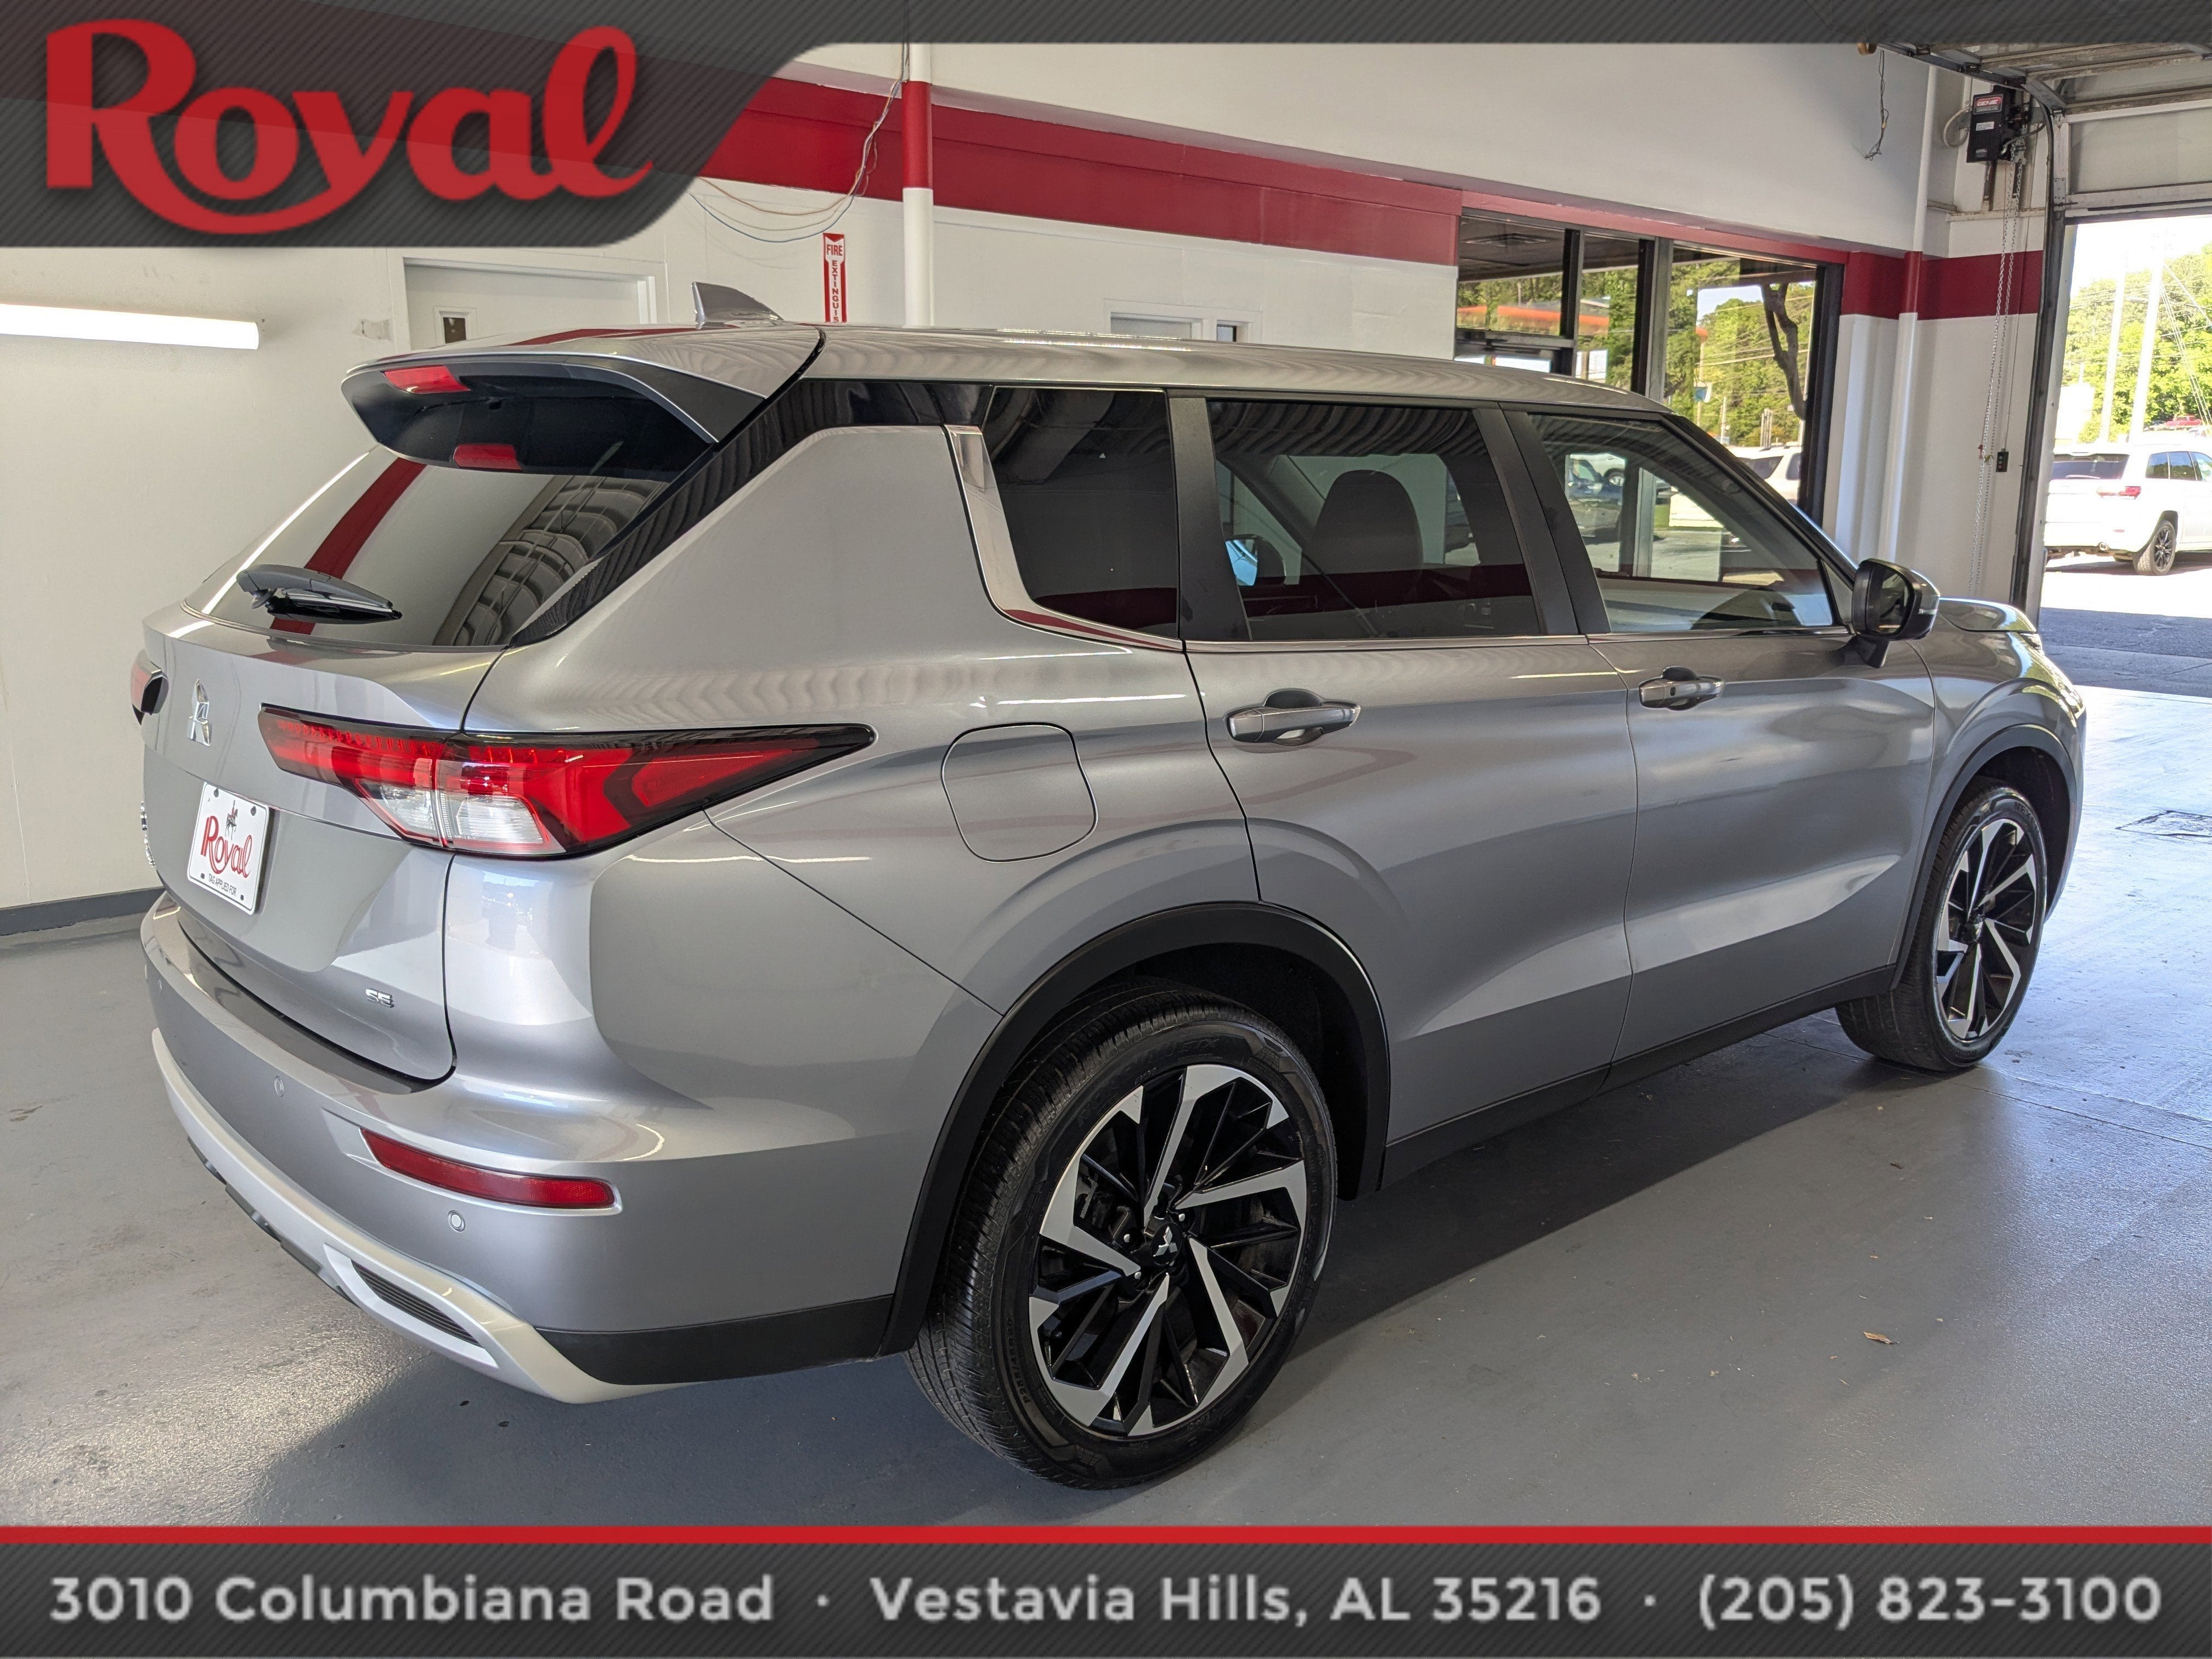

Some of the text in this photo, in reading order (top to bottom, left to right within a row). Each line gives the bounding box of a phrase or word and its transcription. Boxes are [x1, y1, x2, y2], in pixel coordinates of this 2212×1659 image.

[827, 244, 843, 256] FIRE
[201, 815, 252, 878] Royal
[215, 877, 229, 892] APPLIED
[229, 885, 237, 896] FOR
[365, 988, 394, 1008] SE
